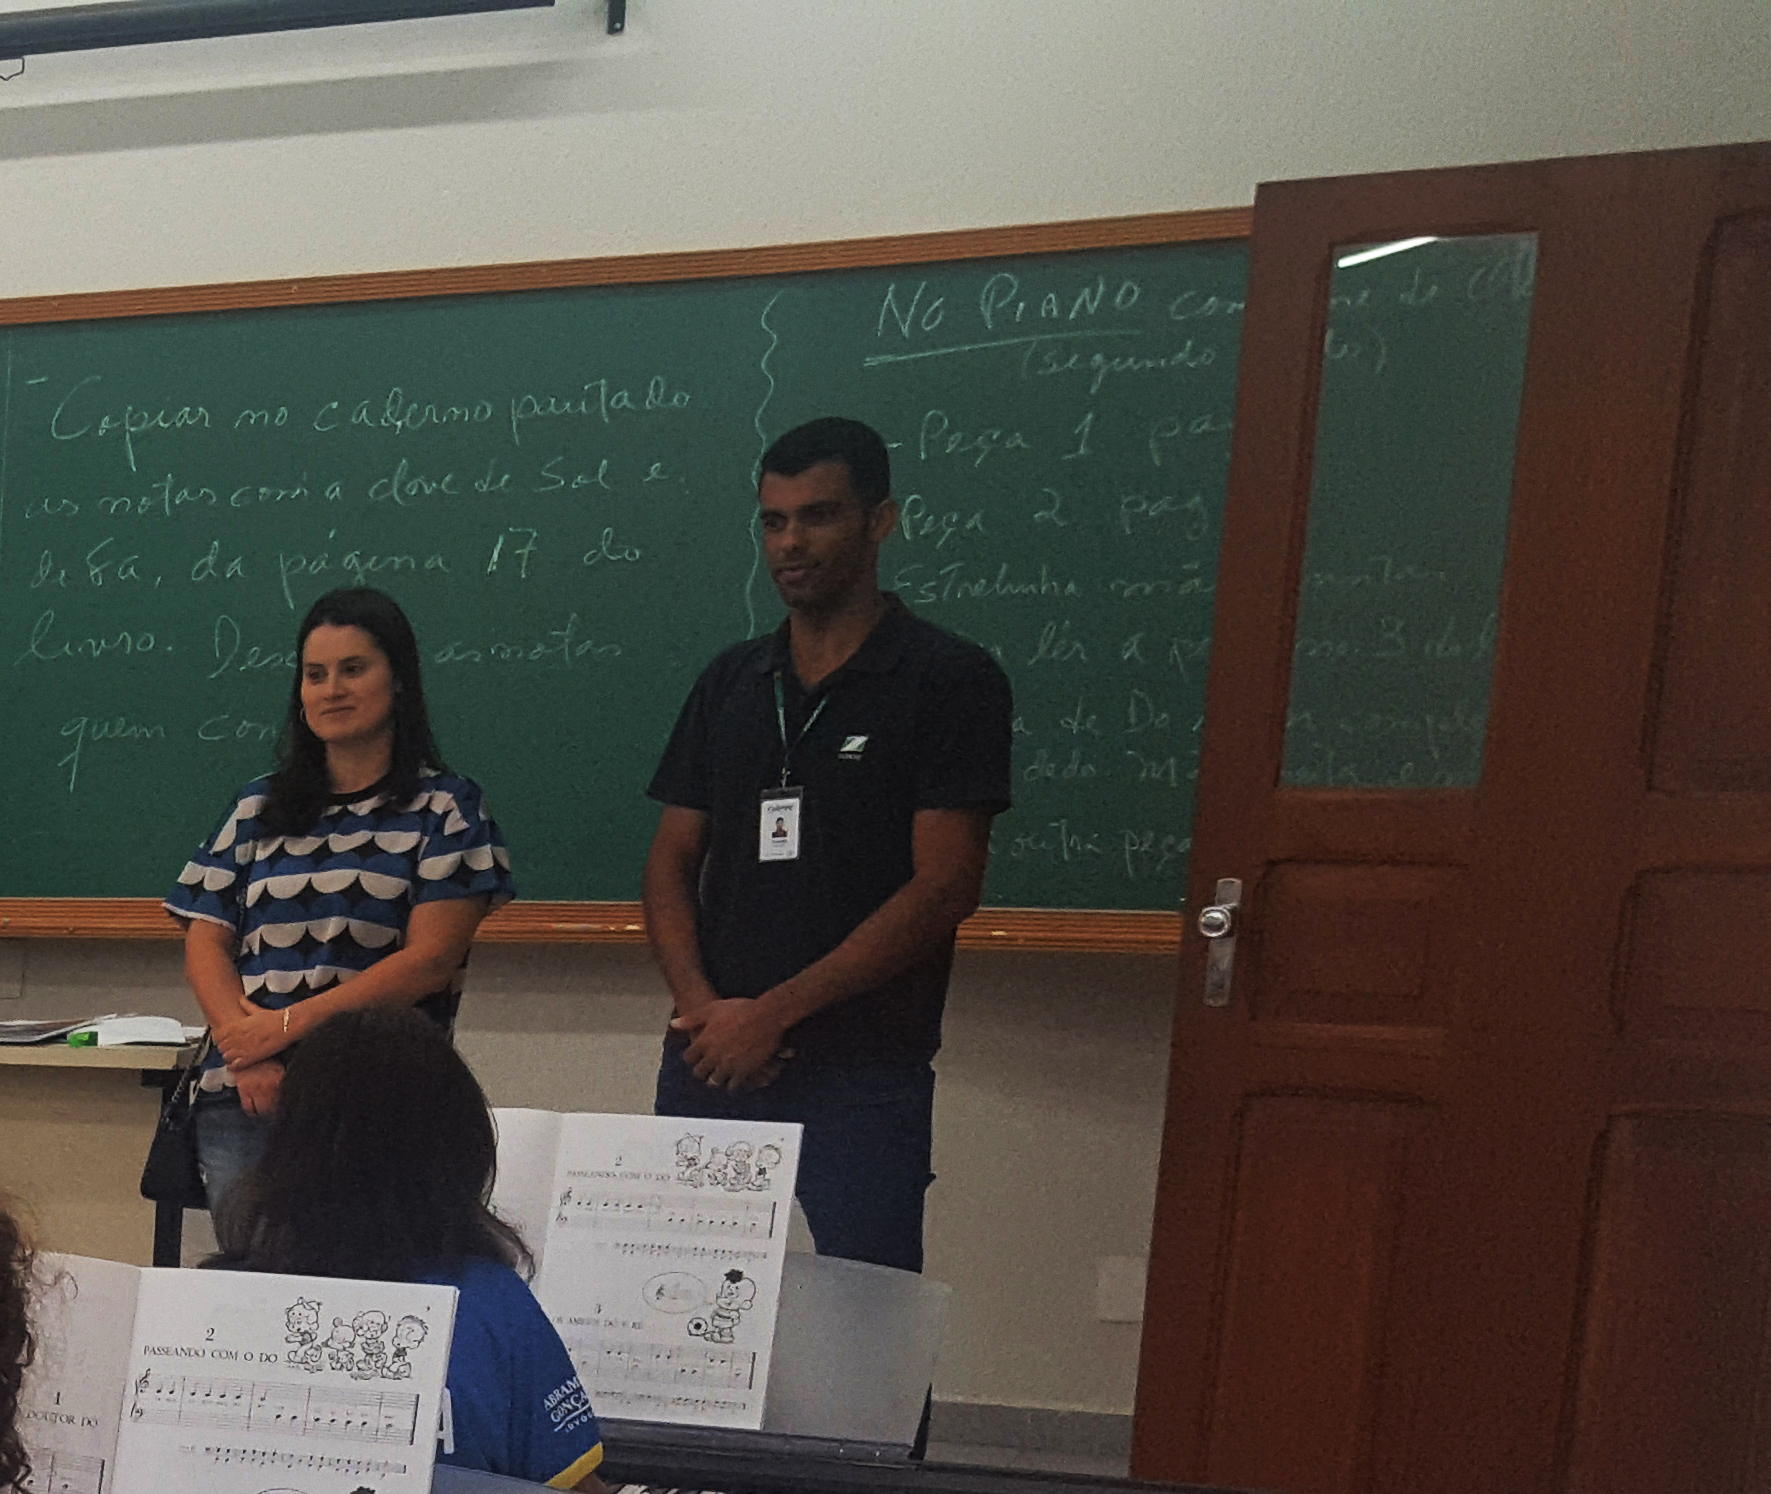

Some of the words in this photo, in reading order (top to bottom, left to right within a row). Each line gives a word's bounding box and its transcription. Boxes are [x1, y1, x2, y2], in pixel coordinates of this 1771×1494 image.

[877, 280, 947, 339] NO
[979, 271, 1143, 331] PIANO
[485, 525, 539, 581] 17
[205, 1327, 216, 1342] 2
[243, 1351, 254, 1362] O
[543, 1376, 580, 1411] ABRAM
